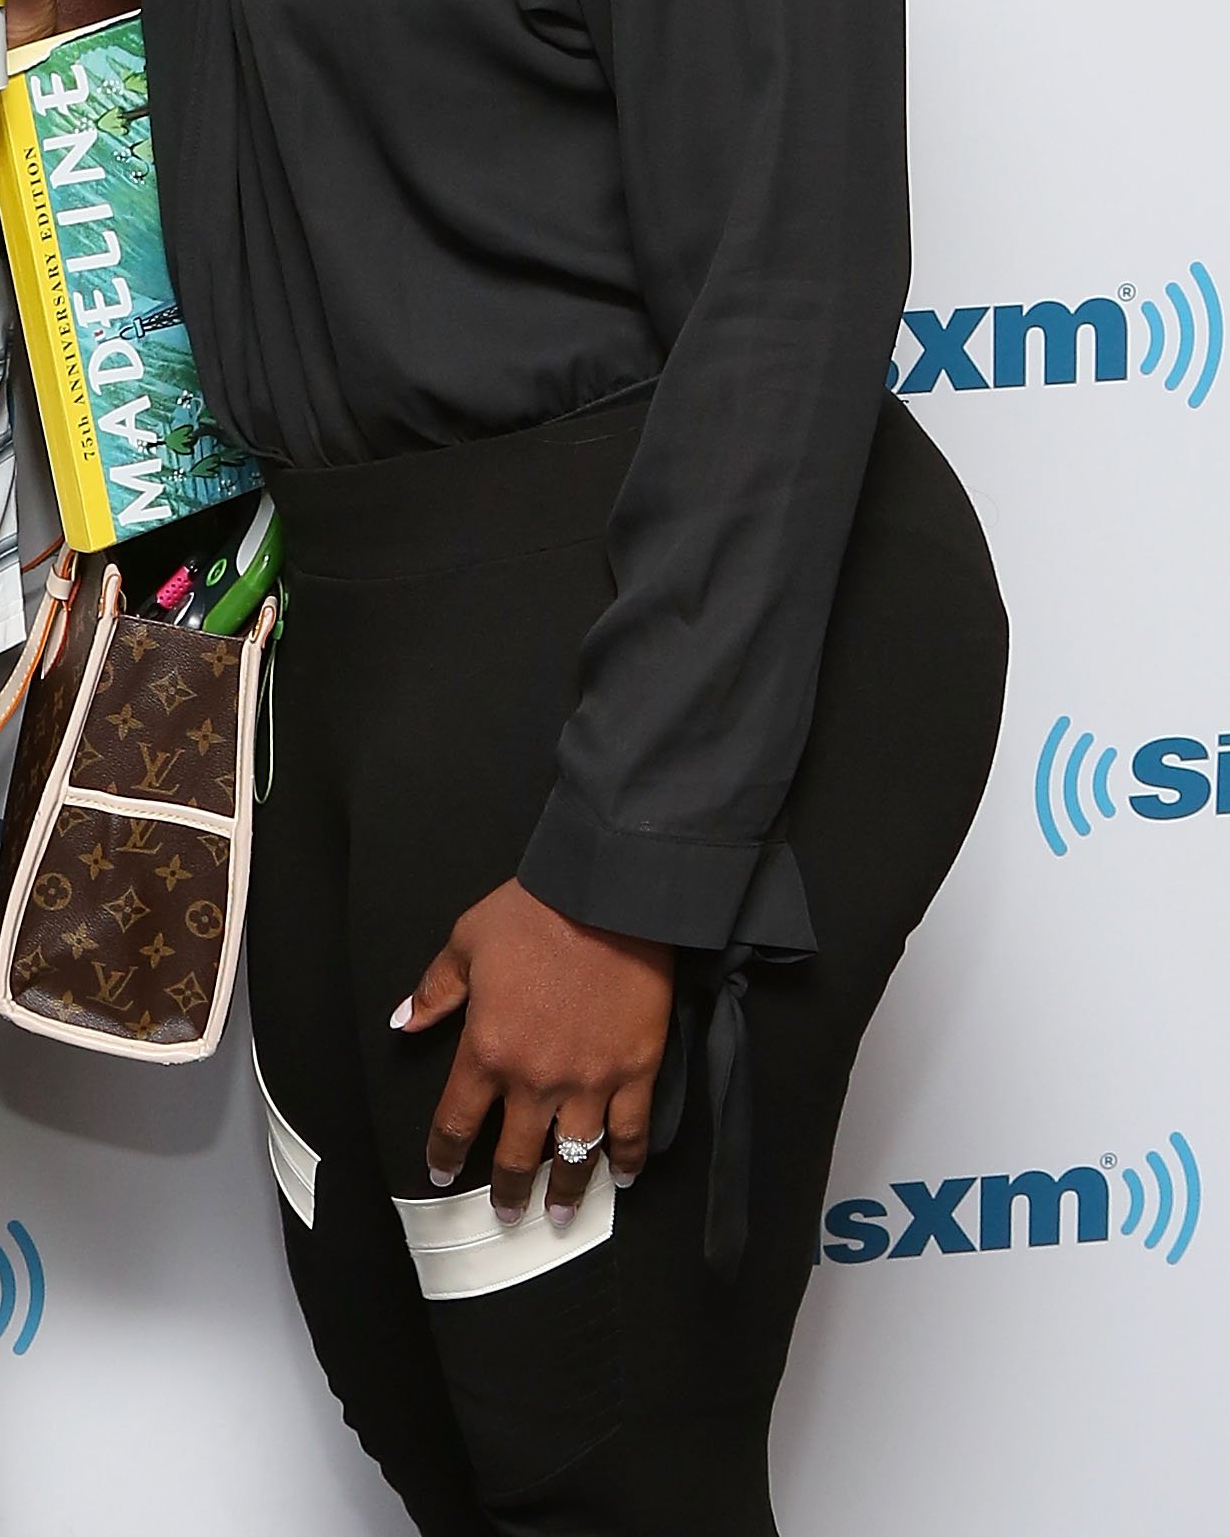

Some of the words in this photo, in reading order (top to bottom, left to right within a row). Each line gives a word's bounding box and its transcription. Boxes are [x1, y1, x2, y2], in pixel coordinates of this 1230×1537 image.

[23, 146, 53, 242] EDITION
[30, 62, 173, 528] MADELINE
[43, 252, 87, 406] ANNIVERSARY
[78, 414, 96, 462] 75th
